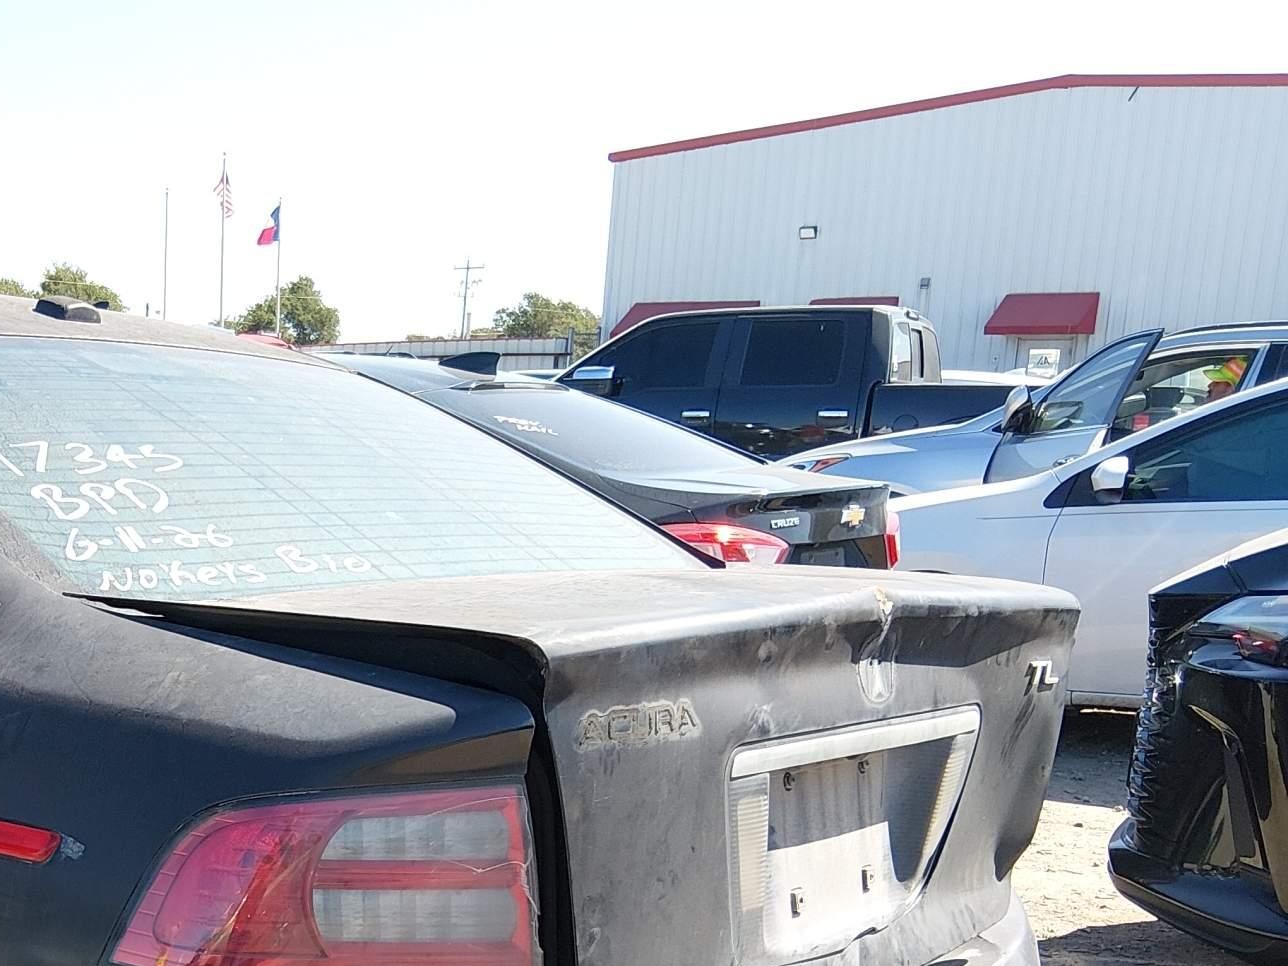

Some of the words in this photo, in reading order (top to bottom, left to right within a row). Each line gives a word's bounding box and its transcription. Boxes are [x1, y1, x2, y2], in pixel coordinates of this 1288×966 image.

[30, 478, 169, 520] BPD
[770, 517, 800, 529] CRUZE
[1029, 659, 1059, 686] TL
[575, 700, 699, 747] ACURA
